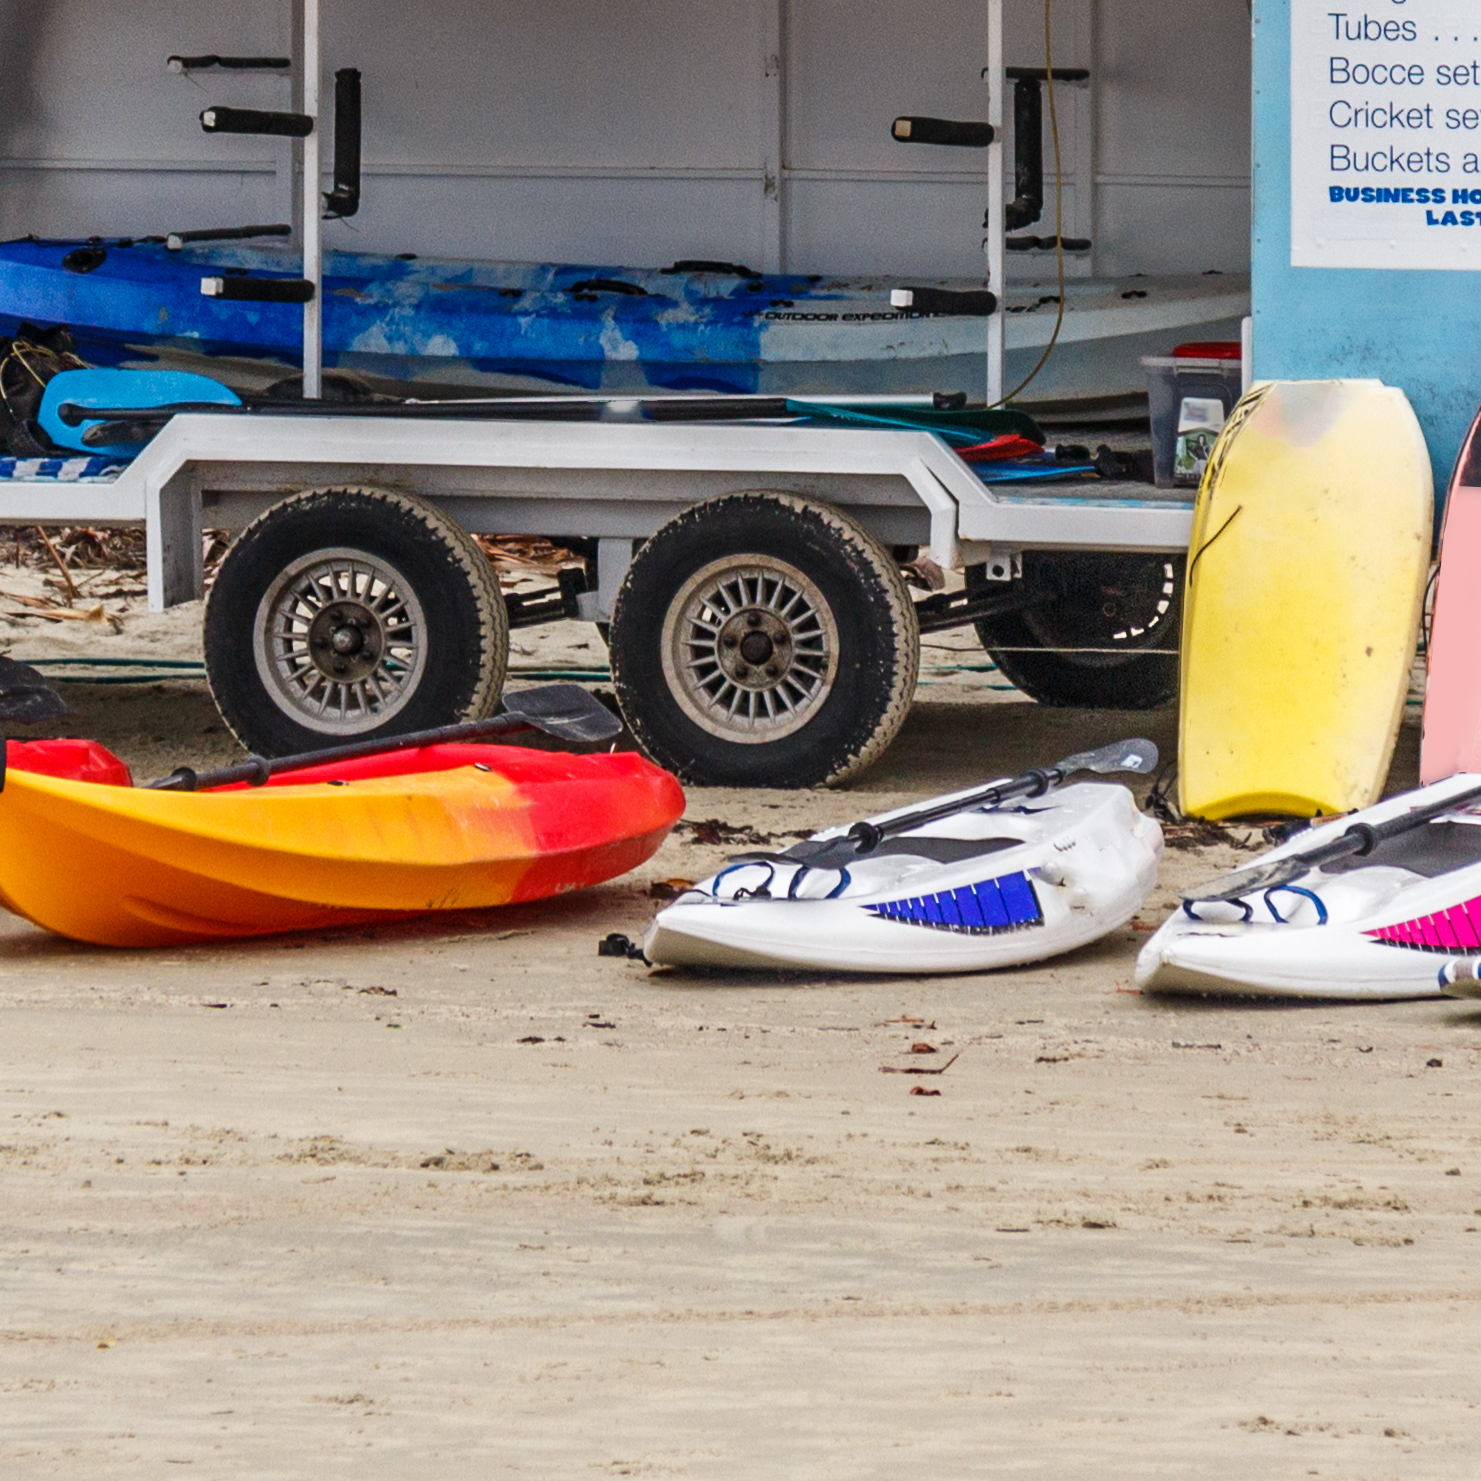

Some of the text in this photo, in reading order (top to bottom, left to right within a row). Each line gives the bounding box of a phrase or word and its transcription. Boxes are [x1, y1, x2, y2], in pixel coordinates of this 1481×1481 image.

[1327, 12, 1417, 42] Tubes
[1329, 56, 1425, 86] Bocce
[1329, 99, 1434, 130] Cricket
[1330, 144, 1451, 174] Buckets
[1328, 185, 1447, 205] BUSINESS
[765, 311, 838, 321] OUTDOOR
